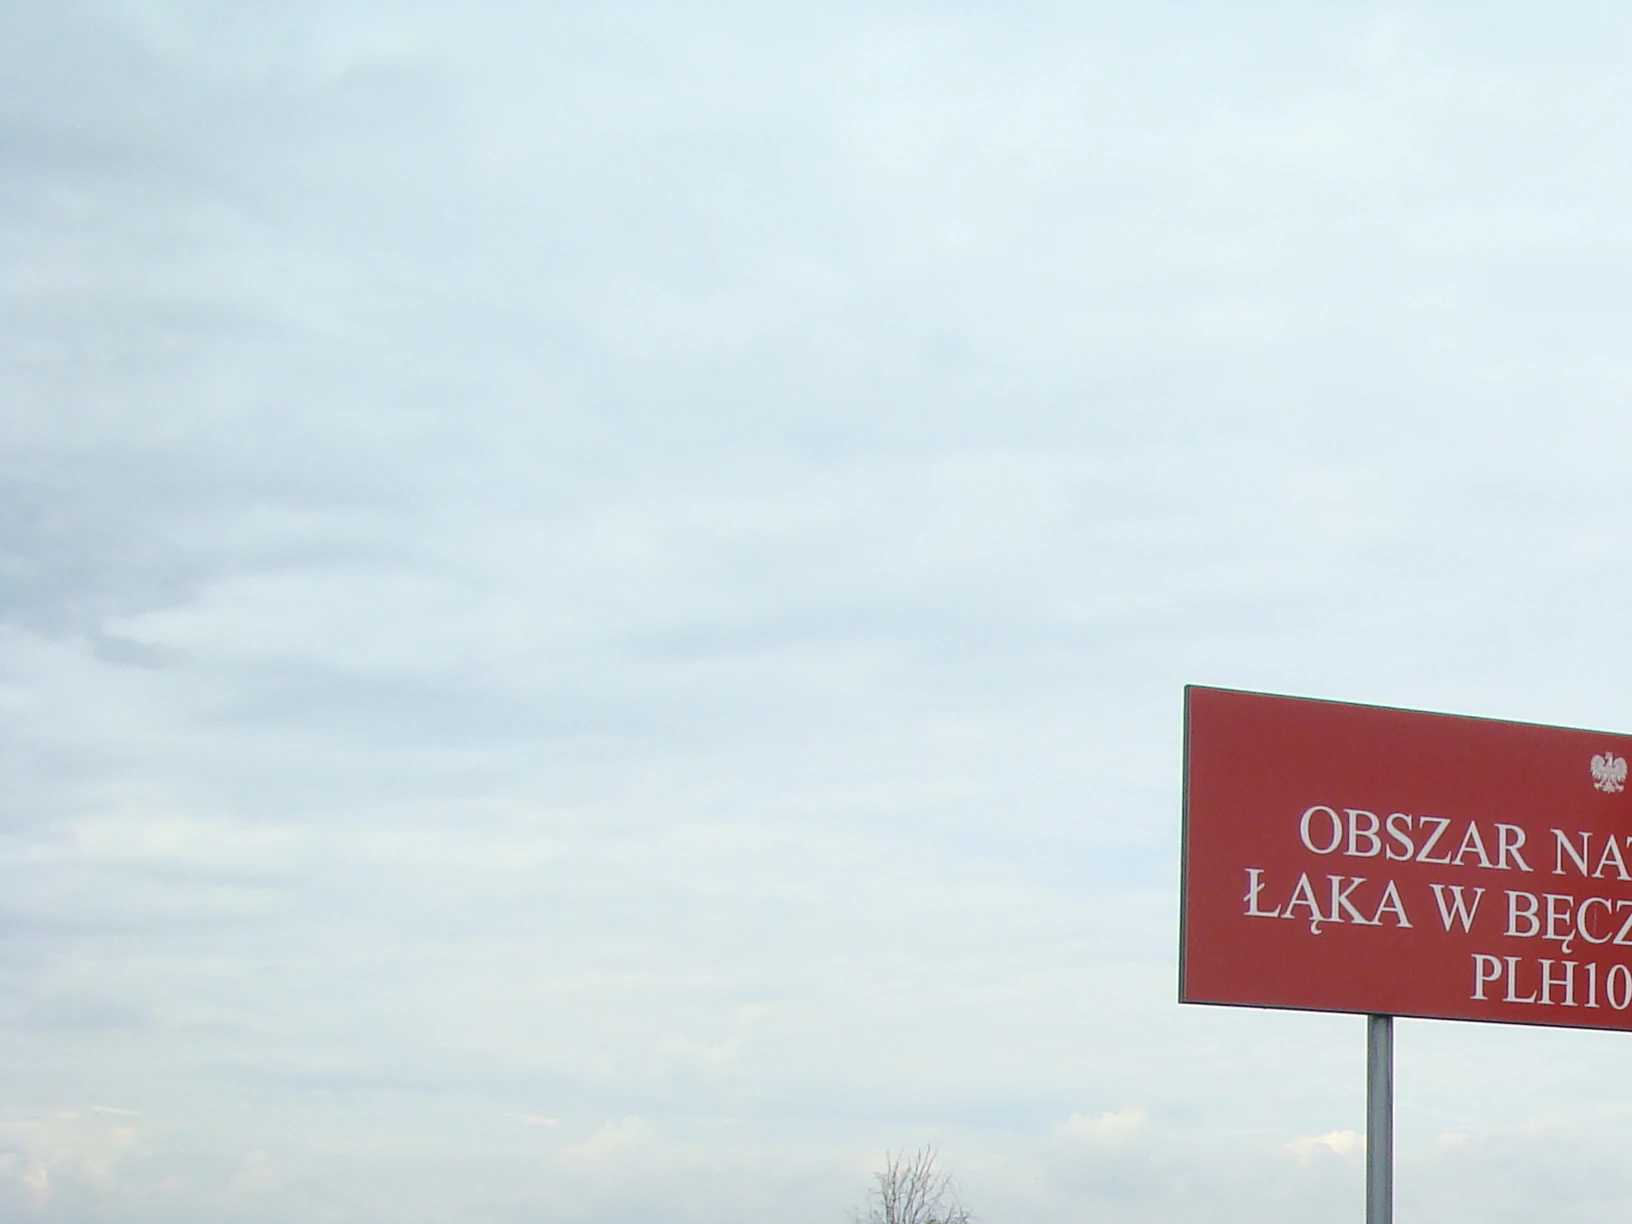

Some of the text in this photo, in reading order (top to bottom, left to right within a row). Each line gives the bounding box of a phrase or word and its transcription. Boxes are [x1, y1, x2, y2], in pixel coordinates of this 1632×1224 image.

[1299, 805, 1534, 872] OBSZAR
[1243, 867, 1414, 935] ŁĄKA
[1429, 883, 1486, 934] W
